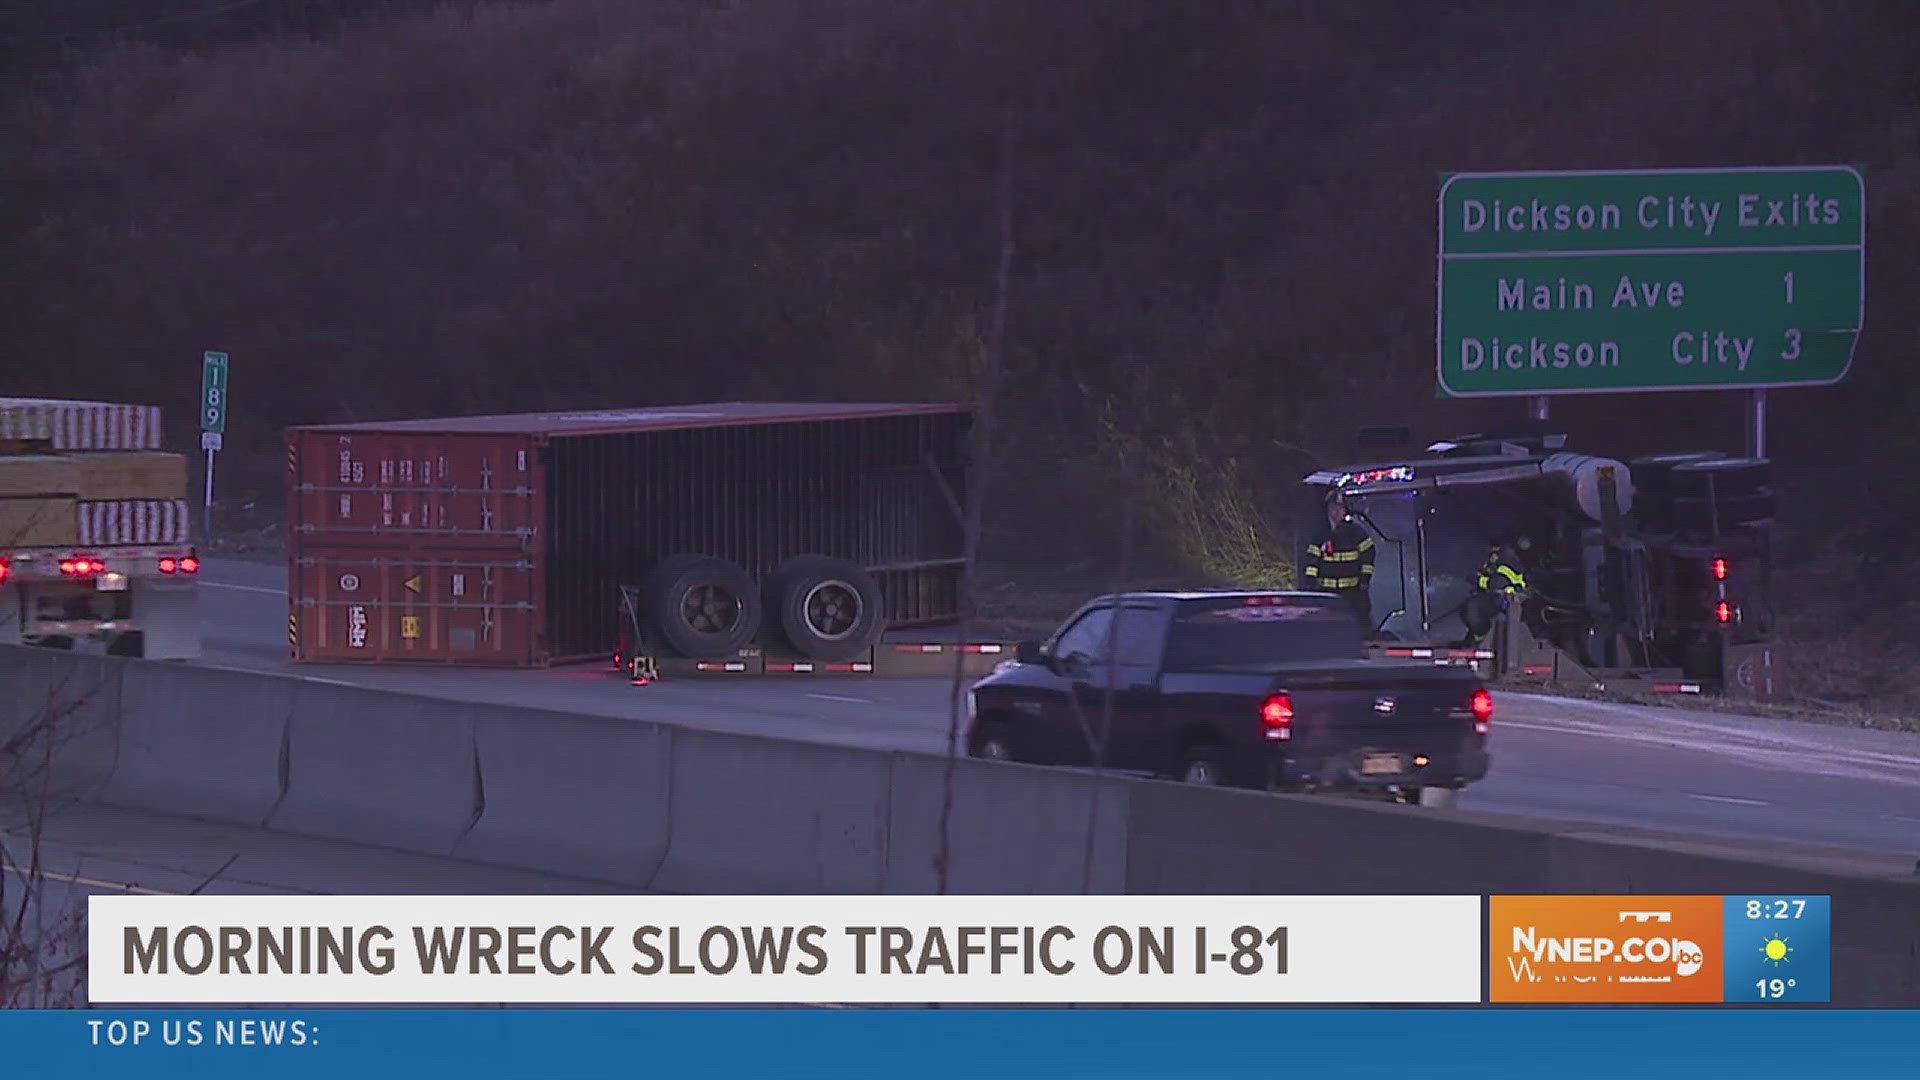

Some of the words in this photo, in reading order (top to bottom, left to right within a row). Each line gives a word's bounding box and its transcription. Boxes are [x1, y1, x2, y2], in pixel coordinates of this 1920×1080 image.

[1463, 199, 1620, 233] Dickson
[1638, 196, 1721, 235] City
[1738, 194, 1840, 226] Exits
[1498, 278, 1593, 311] Main
[1611, 276, 1685, 308] Ave
[1783, 271, 1793, 304] 1
[1461, 337, 1619, 371] Dickson
[1671, 331, 1754, 370] City
[1780, 329, 1801, 360] 3
[207, 366, 220, 426] 189
